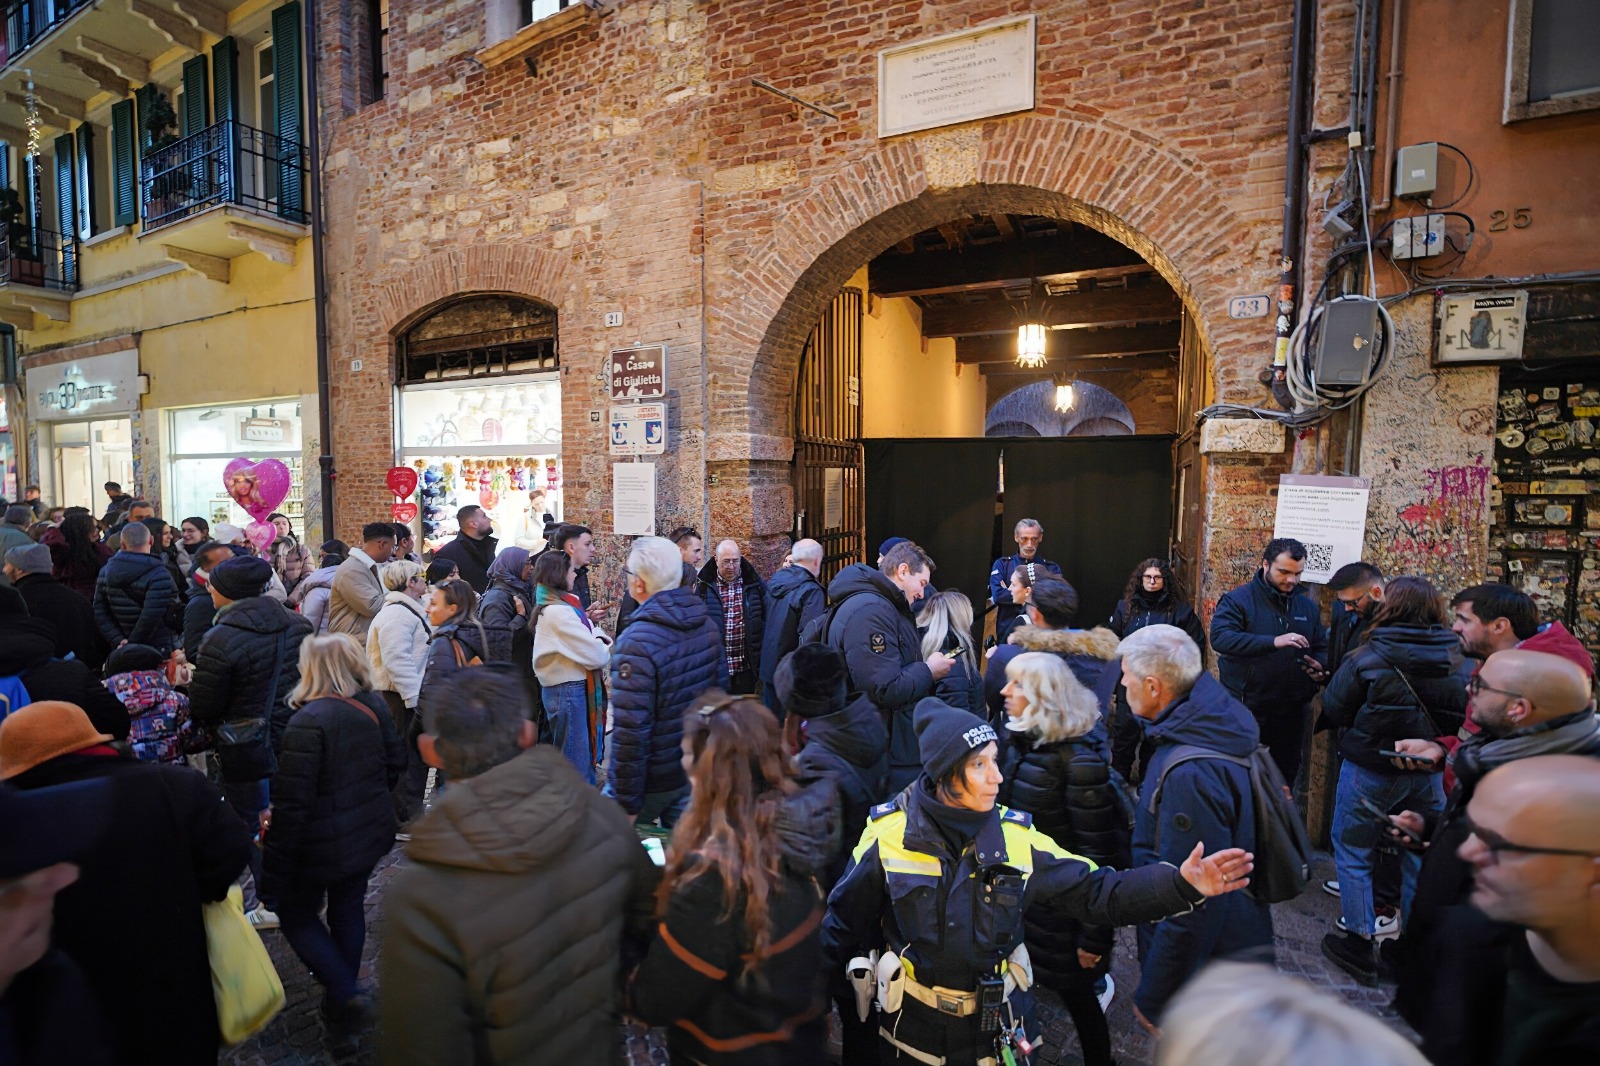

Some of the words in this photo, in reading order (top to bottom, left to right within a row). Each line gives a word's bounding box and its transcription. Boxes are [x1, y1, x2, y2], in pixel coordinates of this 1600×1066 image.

[1489, 206, 1533, 232] 25
[1238, 299, 1260, 317] 23
[608, 313, 619, 324] 21
[626, 360, 648, 371] Casa
[613, 377, 622, 387] di
[623, 374, 661, 387] Giulietta
